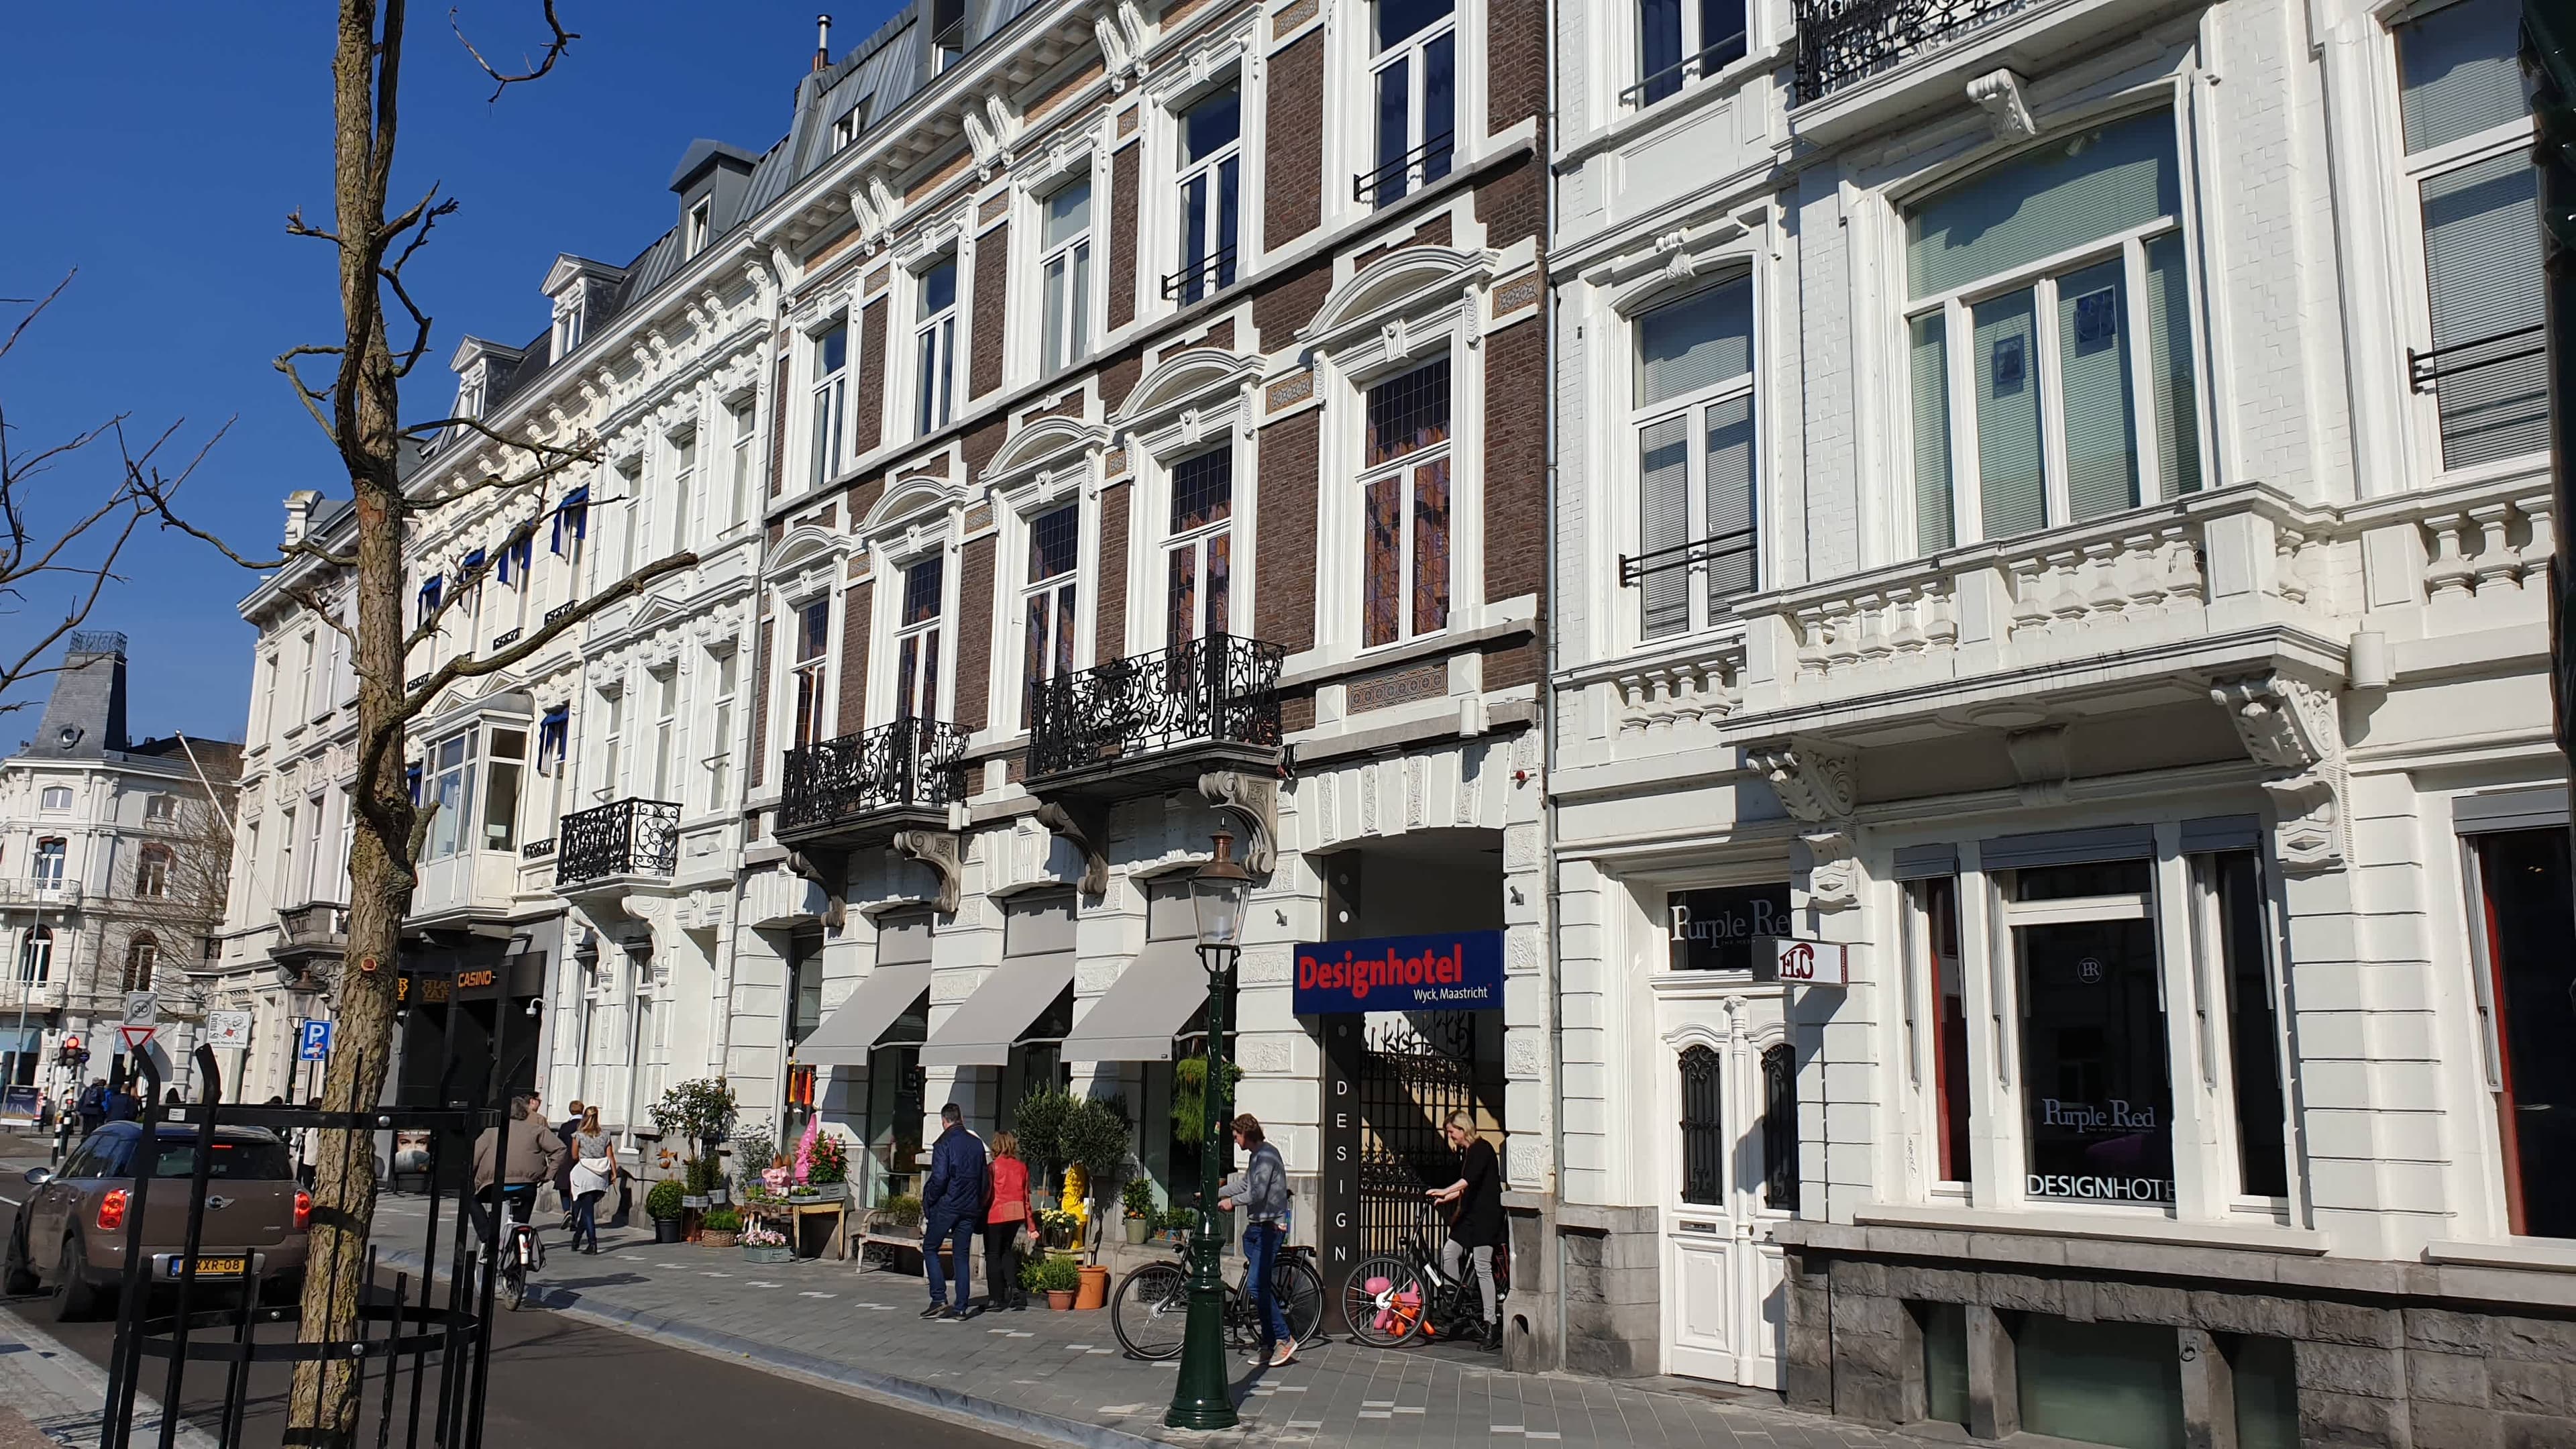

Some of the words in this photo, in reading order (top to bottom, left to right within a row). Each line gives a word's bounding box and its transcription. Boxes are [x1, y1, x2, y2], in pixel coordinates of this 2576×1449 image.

[1670, 905, 1746, 949] Purple
[1750, 899, 1792, 936] Re
[458, 970, 492, 988] CASINO
[1299, 943, 1462, 999] Designhotel
[134, 1004, 148, 1014] 30
[1413, 988, 1439, 1004] Wyck,
[1440, 986, 1488, 1000] Maastricht
[308, 1024, 325, 1044] P
[2041, 1098, 2108, 1134] Purple
[2109, 1099, 2157, 1128] Red
[1334, 1080, 1348, 1262] DESIGN
